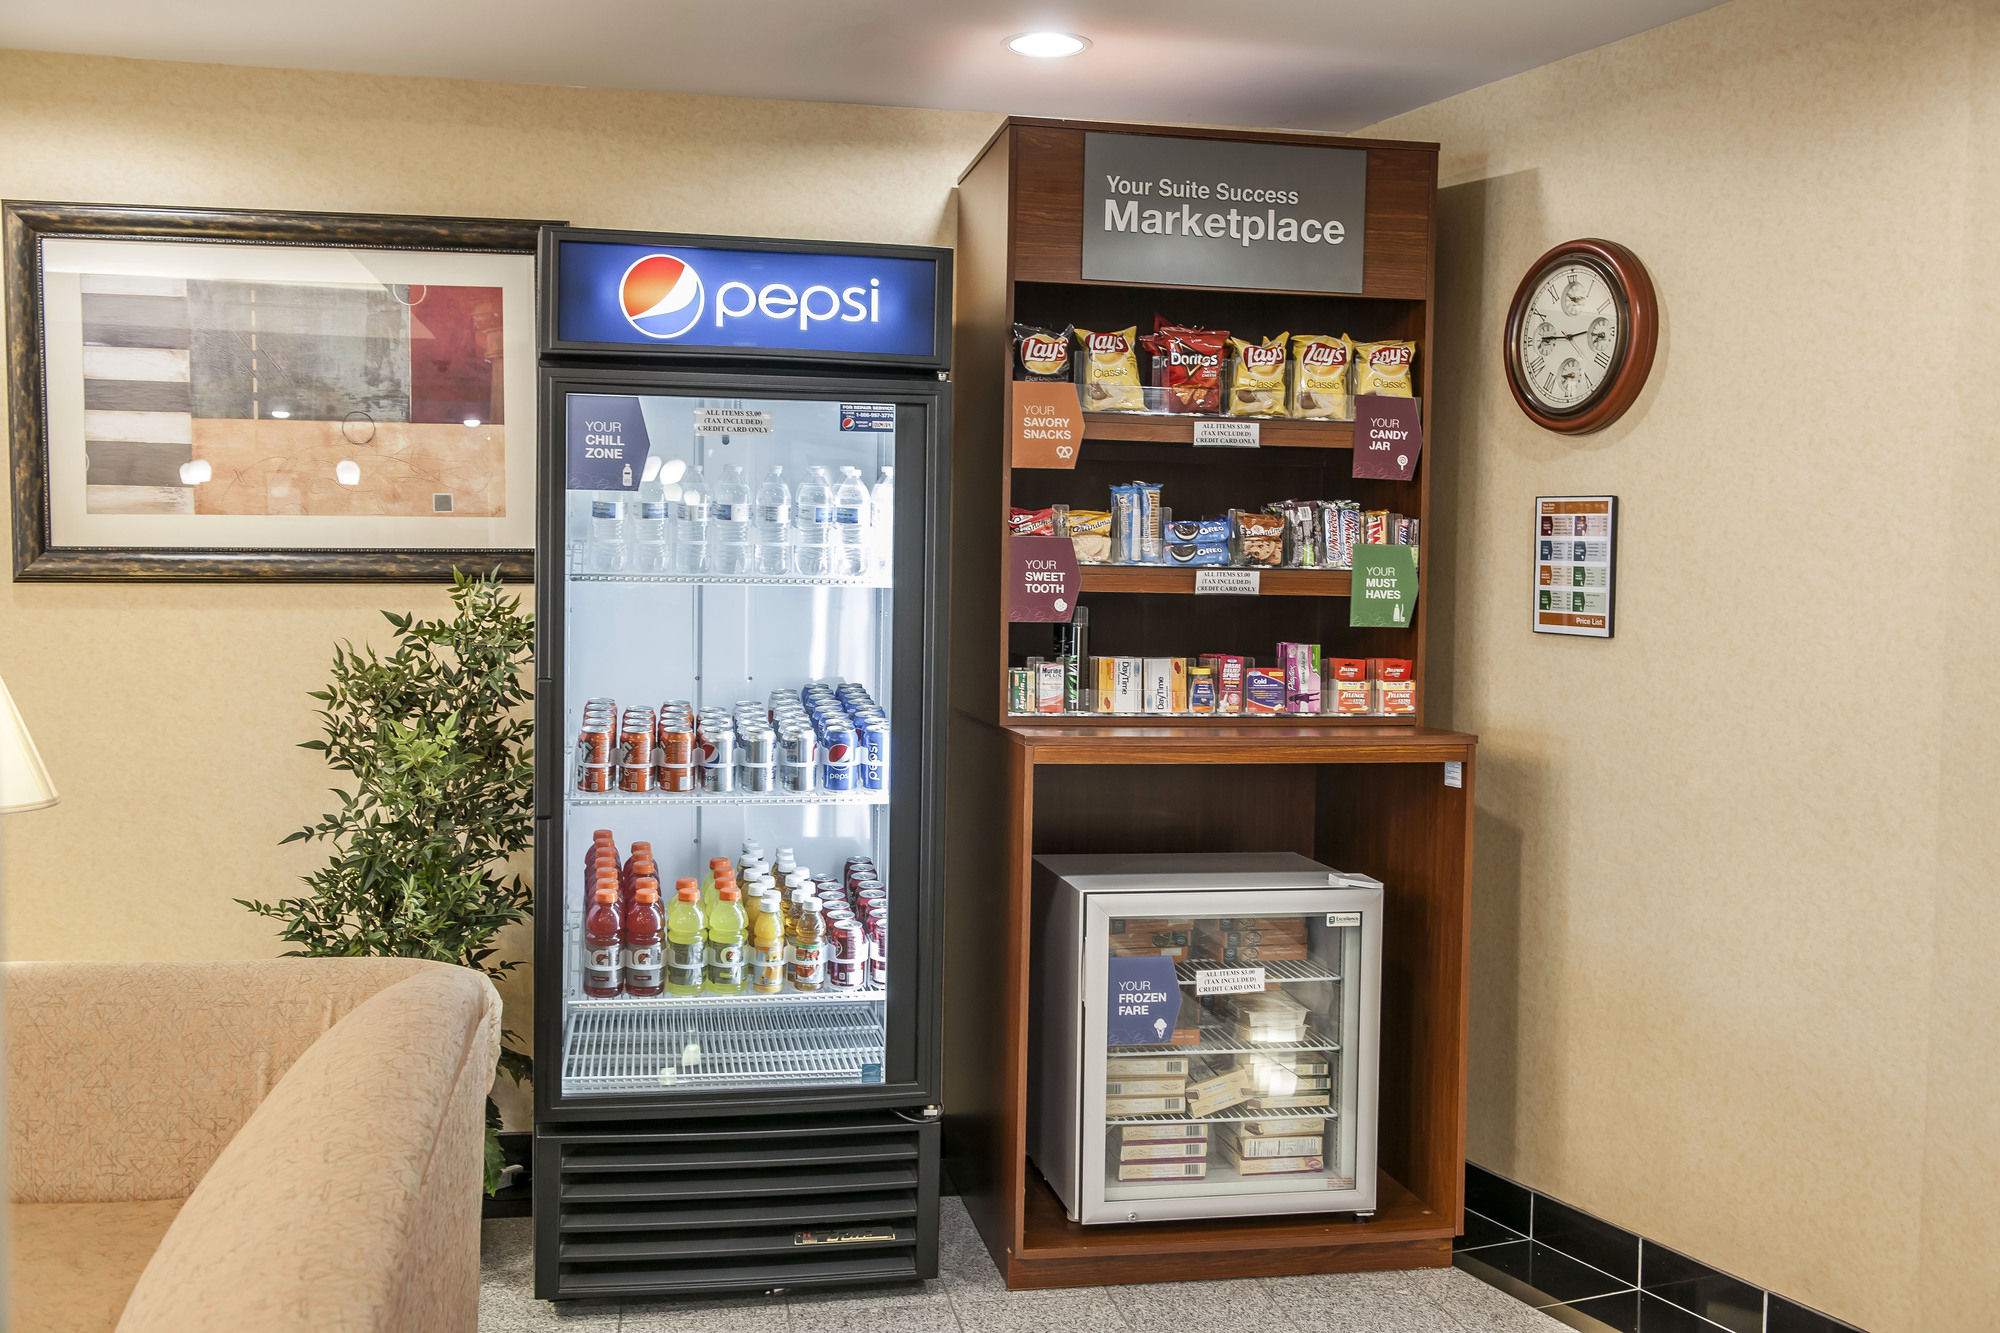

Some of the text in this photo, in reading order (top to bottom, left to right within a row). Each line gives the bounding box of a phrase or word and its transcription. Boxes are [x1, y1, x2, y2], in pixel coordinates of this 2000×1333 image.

[1107, 175, 1299, 204] Your Suite Success
[1104, 199, 1346, 247] Marketplace
[716, 278, 880, 330] pepsi
[1090, 333, 1124, 354] Lay's
[1024, 338, 1067, 362] Lay's
[1247, 343, 1283, 367] Lay's
[1303, 343, 1345, 366] Lay's
[1170, 352, 1218, 366] Doritos
[1370, 346, 1411, 366] Lay's
[1093, 367, 1128, 378] Classic
[1249, 378, 1282, 389] Classic
[1306, 378, 1340, 389] Classic
[1372, 377, 1407, 389] Classic
[1023, 405, 1055, 416] YOUR
[585, 420, 622, 433] YOUR
[1023, 417, 1070, 428] SAVORY
[1369, 417, 1400, 428] YOUR
[585, 433, 625, 447] CHILL
[1023, 429, 1072, 440] SNACKS
[1369, 429, 1409, 441] CANDY
[1369, 441, 1391, 451] JAR
[585, 447, 623, 460] ZONE
[1199, 525, 1224, 535] OREO
[1329, 508, 1339, 551] Musketeer
[1368, 516, 1384, 544] TW
[1196, 547, 1223, 556] OREO
[1025, 560, 1057, 570] YOUR
[1366, 566, 1396, 576] YOUR
[1025, 572, 1066, 582] SWEET
[1025, 583, 1065, 594] TOOTH
[1365, 578, 1398, 588] MUST
[1365, 590, 1401, 599] HAVES
[1042, 667, 1062, 675] Murine
[1018, 682, 1026, 710] Aspirin
[1157, 676, 1165, 710] DayTime
[829, 773, 849, 781] peps
[1118, 980, 1151, 991] YOUR
[1118, 992, 1167, 1004] FROZEN
[1118, 1005, 1150, 1016] FARE
